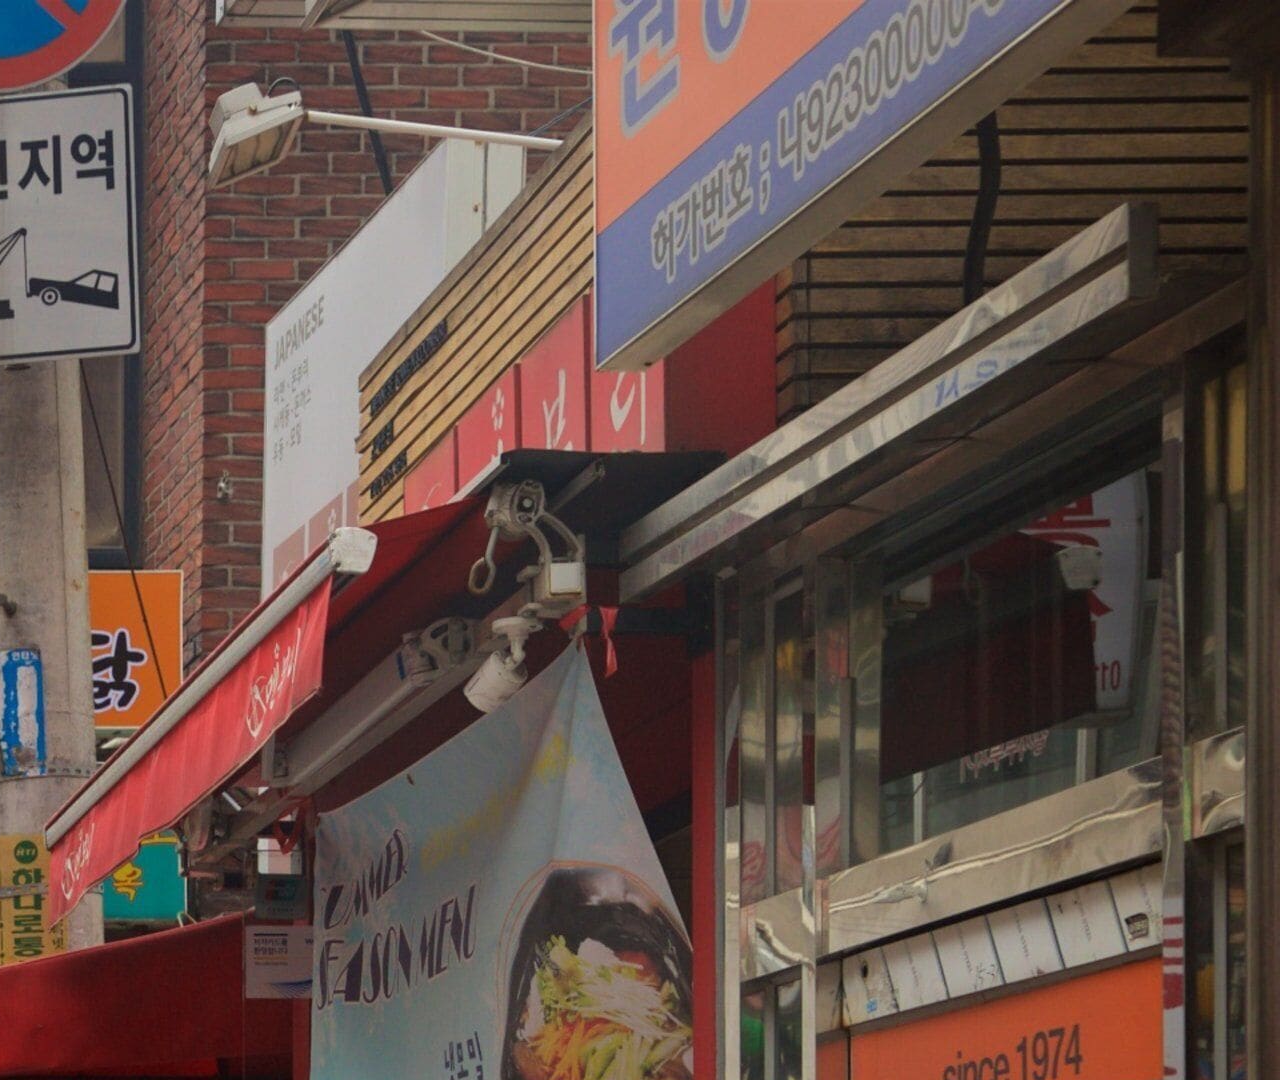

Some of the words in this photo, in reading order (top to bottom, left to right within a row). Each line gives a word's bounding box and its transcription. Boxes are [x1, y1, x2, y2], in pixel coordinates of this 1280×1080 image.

[652, 147, 753, 282] 허가번호
[777, 0, 1002, 180] 나92300000-
[273, 295, 326, 371] JAPANESE
